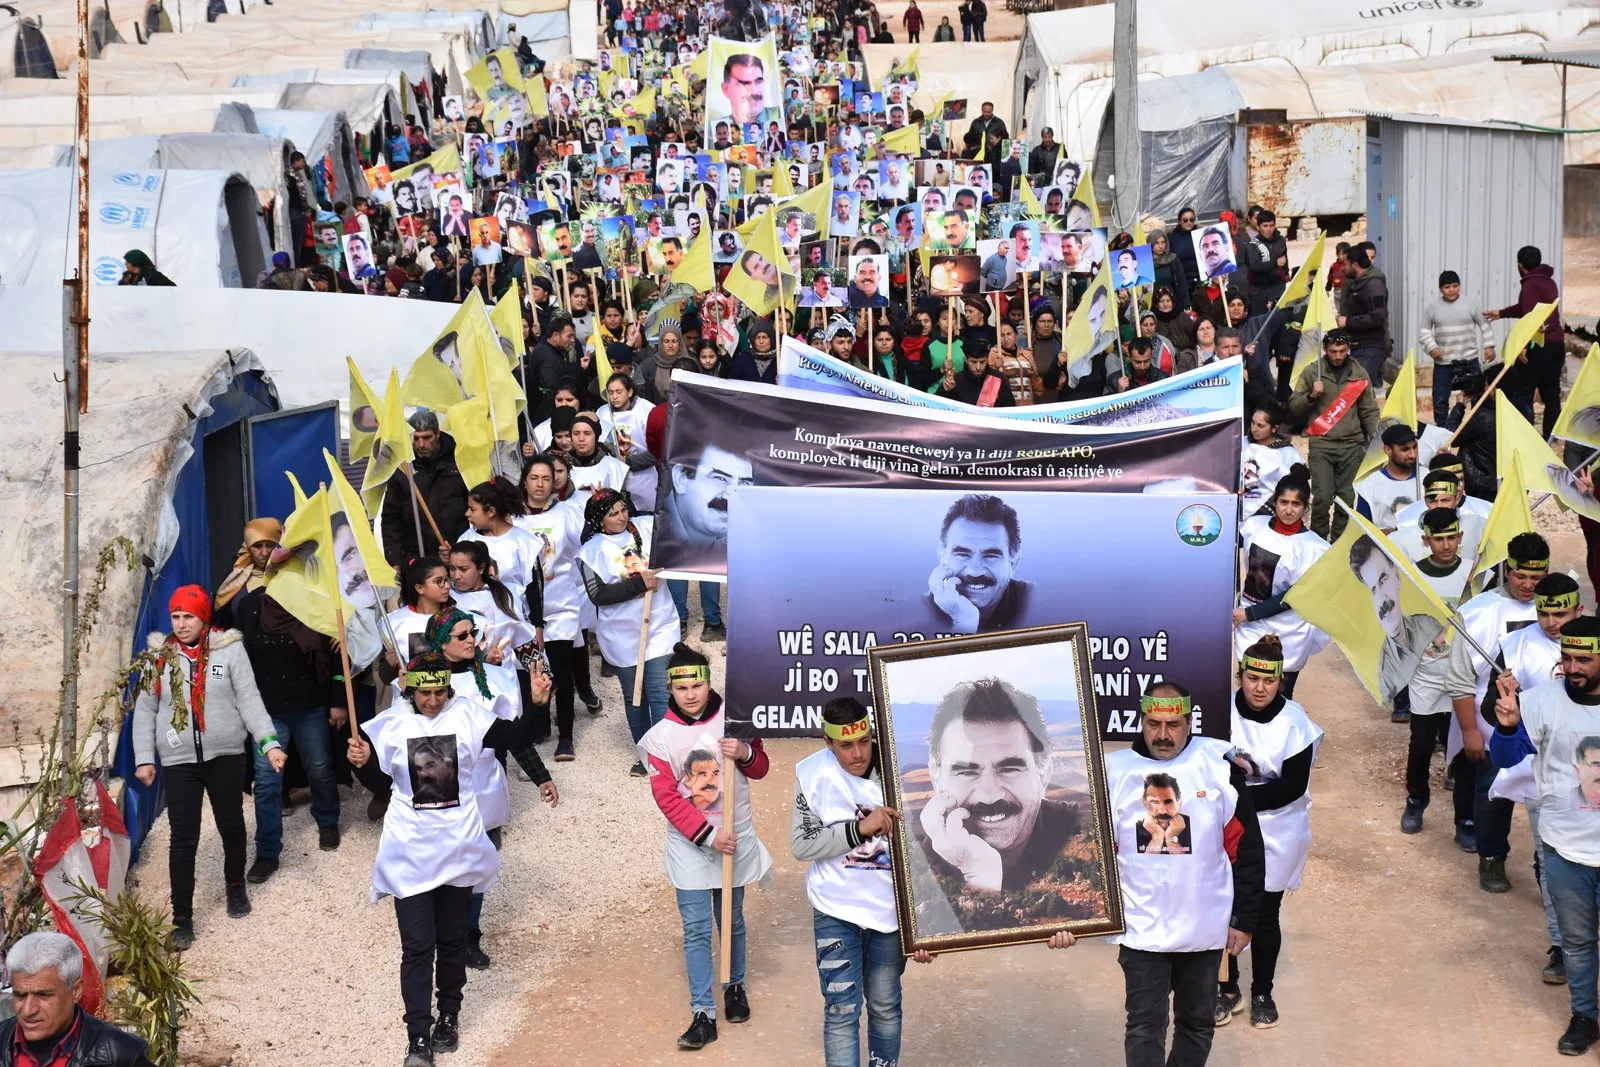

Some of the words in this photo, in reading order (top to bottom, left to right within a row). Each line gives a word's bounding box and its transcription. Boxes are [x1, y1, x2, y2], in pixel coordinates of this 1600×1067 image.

[1358, 0, 1443, 19] unicef
[798, 354, 843, 380] Projeya
[844, 372, 887, 397] Netewa
[794, 427, 864, 452] Komploya
[867, 441, 954, 460] navneteweyî
[957, 450, 972, 461] ya
[975, 448, 986, 459] li
[1060, 445, 1096, 460] APO,
[769, 444, 847, 467] komployek
[850, 454, 859, 468] li
[862, 457, 886, 473] dijî
[889, 459, 919, 473] vîna
[921, 462, 964, 476] gelan,
[967, 464, 1043, 477] demokrasî
[1045, 466, 1055, 477] û
[1058, 464, 1105, 481] aşitiyê
[1107, 467, 1123, 481] ye
[778, 625, 813, 656] WÊ
[824, 631, 878, 656] SALA
[1089, 637, 1130, 661] PLO
[1141, 631, 1168, 661] YÊ
[1253, 661, 1268, 669] APO
[808, 668, 839, 692] BO
[751, 705, 822, 730] GELAN
[841, 720, 867, 736] APO
